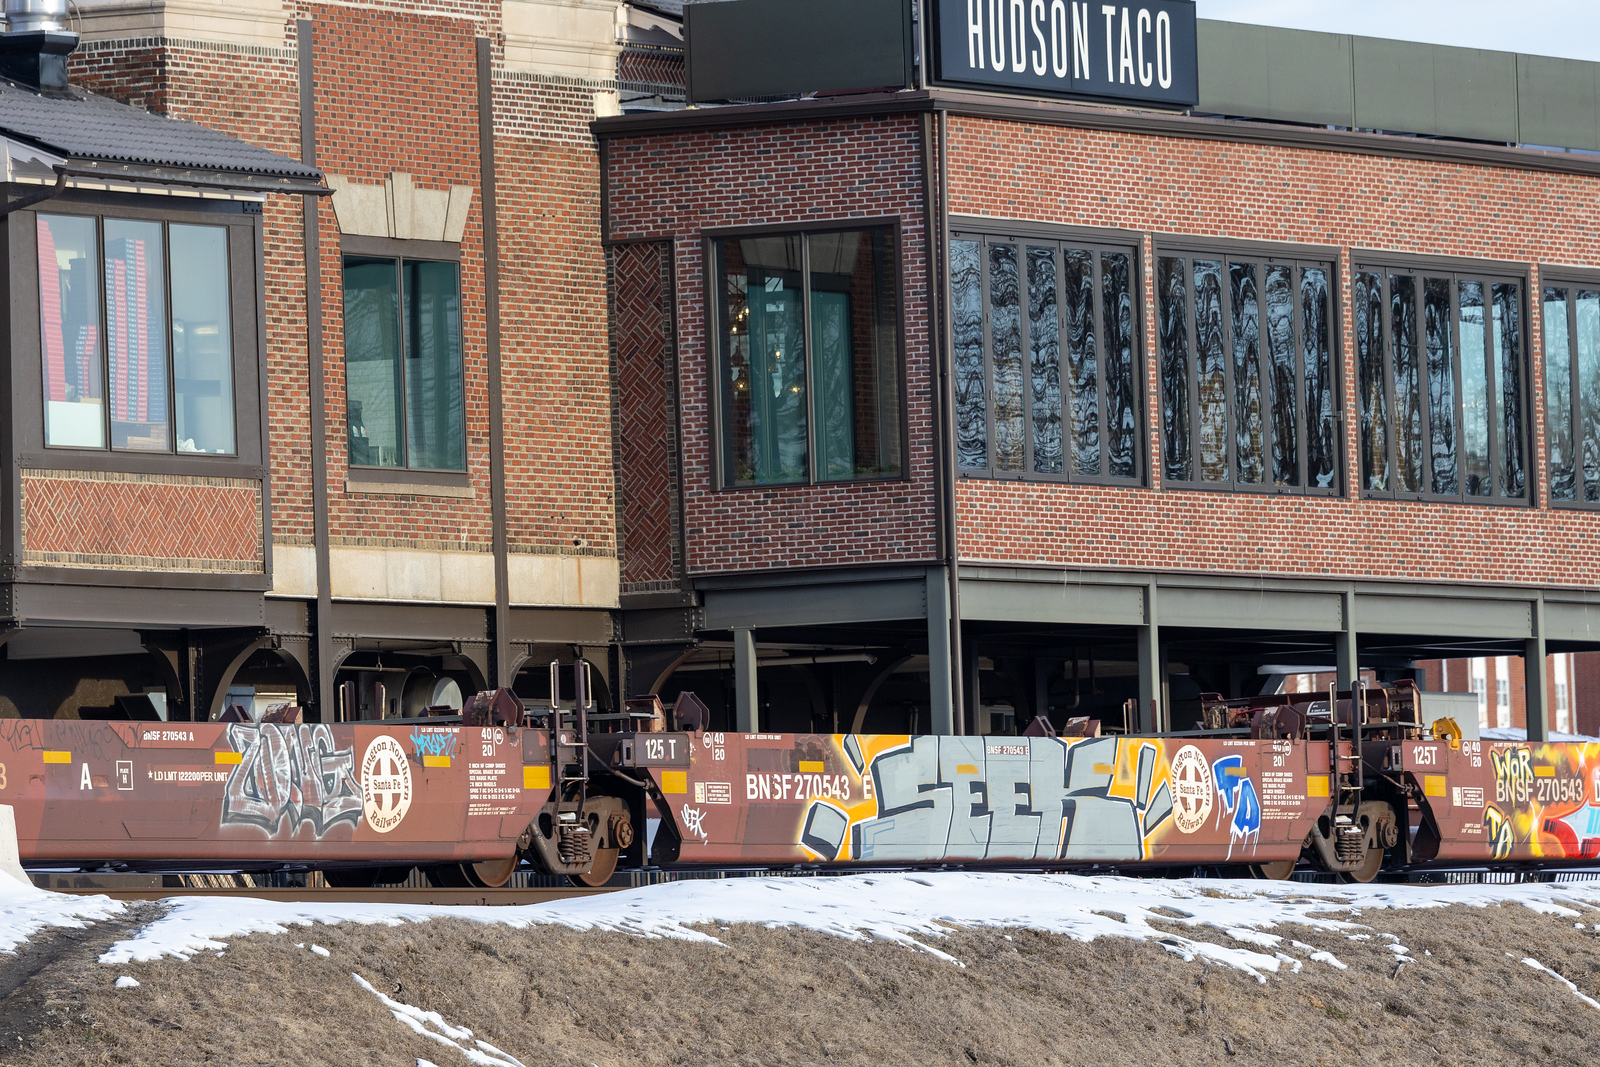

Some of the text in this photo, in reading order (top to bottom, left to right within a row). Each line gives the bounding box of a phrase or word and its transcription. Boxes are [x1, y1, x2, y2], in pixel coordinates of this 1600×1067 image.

[967, 0, 1172, 90] HUDSON TACO
[162, 731, 187, 741] 270543
[189, 732, 194, 741] A
[481, 728, 492, 740] 40
[714, 733, 724, 744] 40
[482, 744, 492, 756] 20
[646, 739, 664, 760] 125
[668, 739, 676, 759] T
[987, 746, 1001, 755] BNSF
[1003, 746, 1024, 755] 270543
[1472, 742, 1481, 752] 40
[715, 749, 725, 760] 20
[1273, 756, 1282, 766] 20
[1473, 757, 1482, 767] 20
[80, 763, 93, 790] A
[154, 771, 163, 781] LD
[164, 771, 177, 781] LMT
[214, 772, 228, 782] UNIT
[364, 741, 386, 802] Burlington
[388, 741, 409, 800] Northern
[122, 774, 127, 784] H
[1172, 750, 1210, 806] Burlington Northern
[373, 779, 401, 790] Santa Fe
[746, 774, 872, 800] BNSF 270543 E
[1180, 784, 1203, 795] Santa Fe
[1496, 779, 1533, 802] BNSF
[1537, 779, 1583, 801] 270543
[370, 808, 402, 828] Railway
[1177, 812, 1204, 830] Railway
